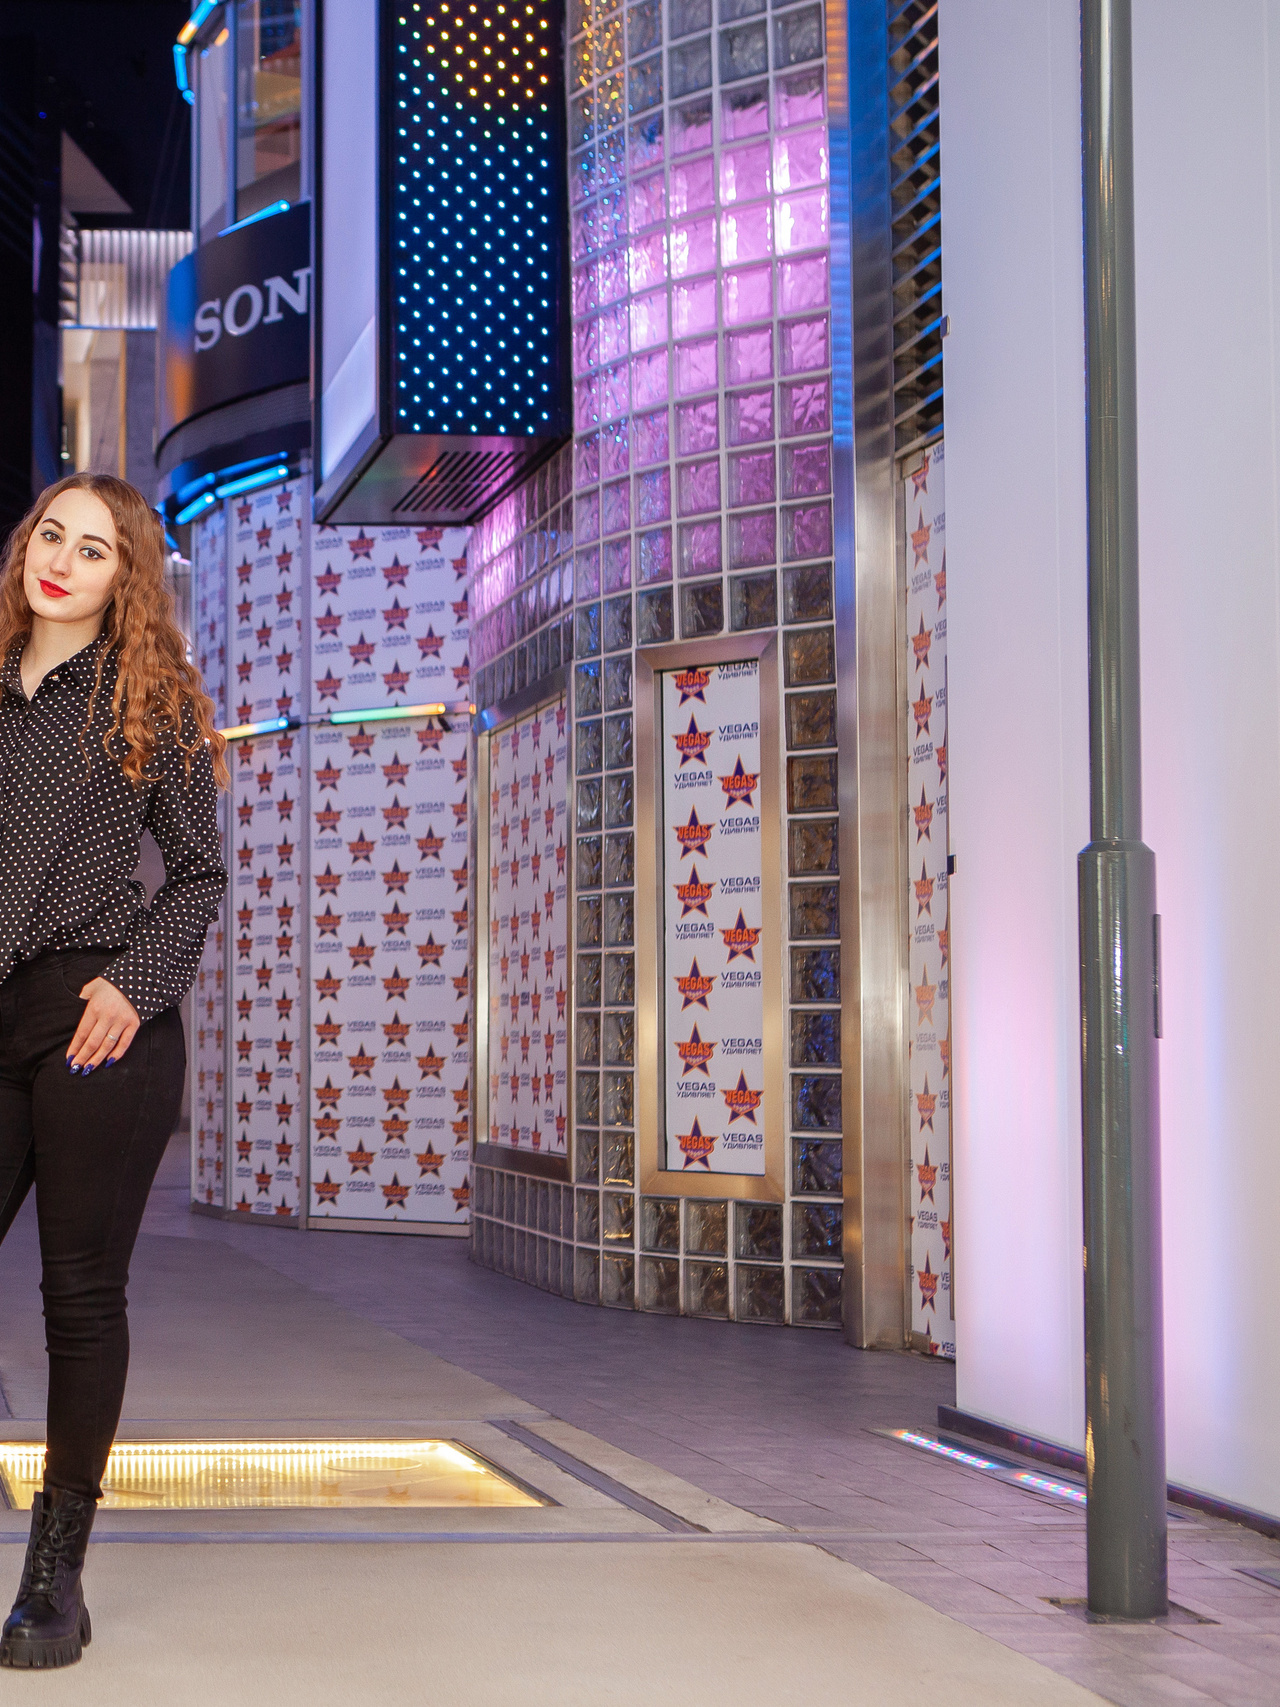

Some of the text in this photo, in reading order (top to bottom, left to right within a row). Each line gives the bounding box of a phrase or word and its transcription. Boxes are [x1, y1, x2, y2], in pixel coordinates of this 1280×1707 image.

[718, 661, 757, 672] VEGAS
[718, 722, 758, 734] VEGAS
[913, 742, 933, 756] VEGAS
[674, 771, 713, 782] VEGAS
[720, 816, 760, 828] VEGAS
[720, 877, 760, 887] VEGAS
[675, 924, 714, 933] VEGAS
[915, 924, 934, 935] VEGAS
[721, 971, 761, 980] VEGAS
[722, 1038, 762, 1047] VEGAS
[677, 1082, 716, 1091] VEGAS
[722, 1134, 763, 1142] VEGAS
[917, 1210, 937, 1221] VEGAS
